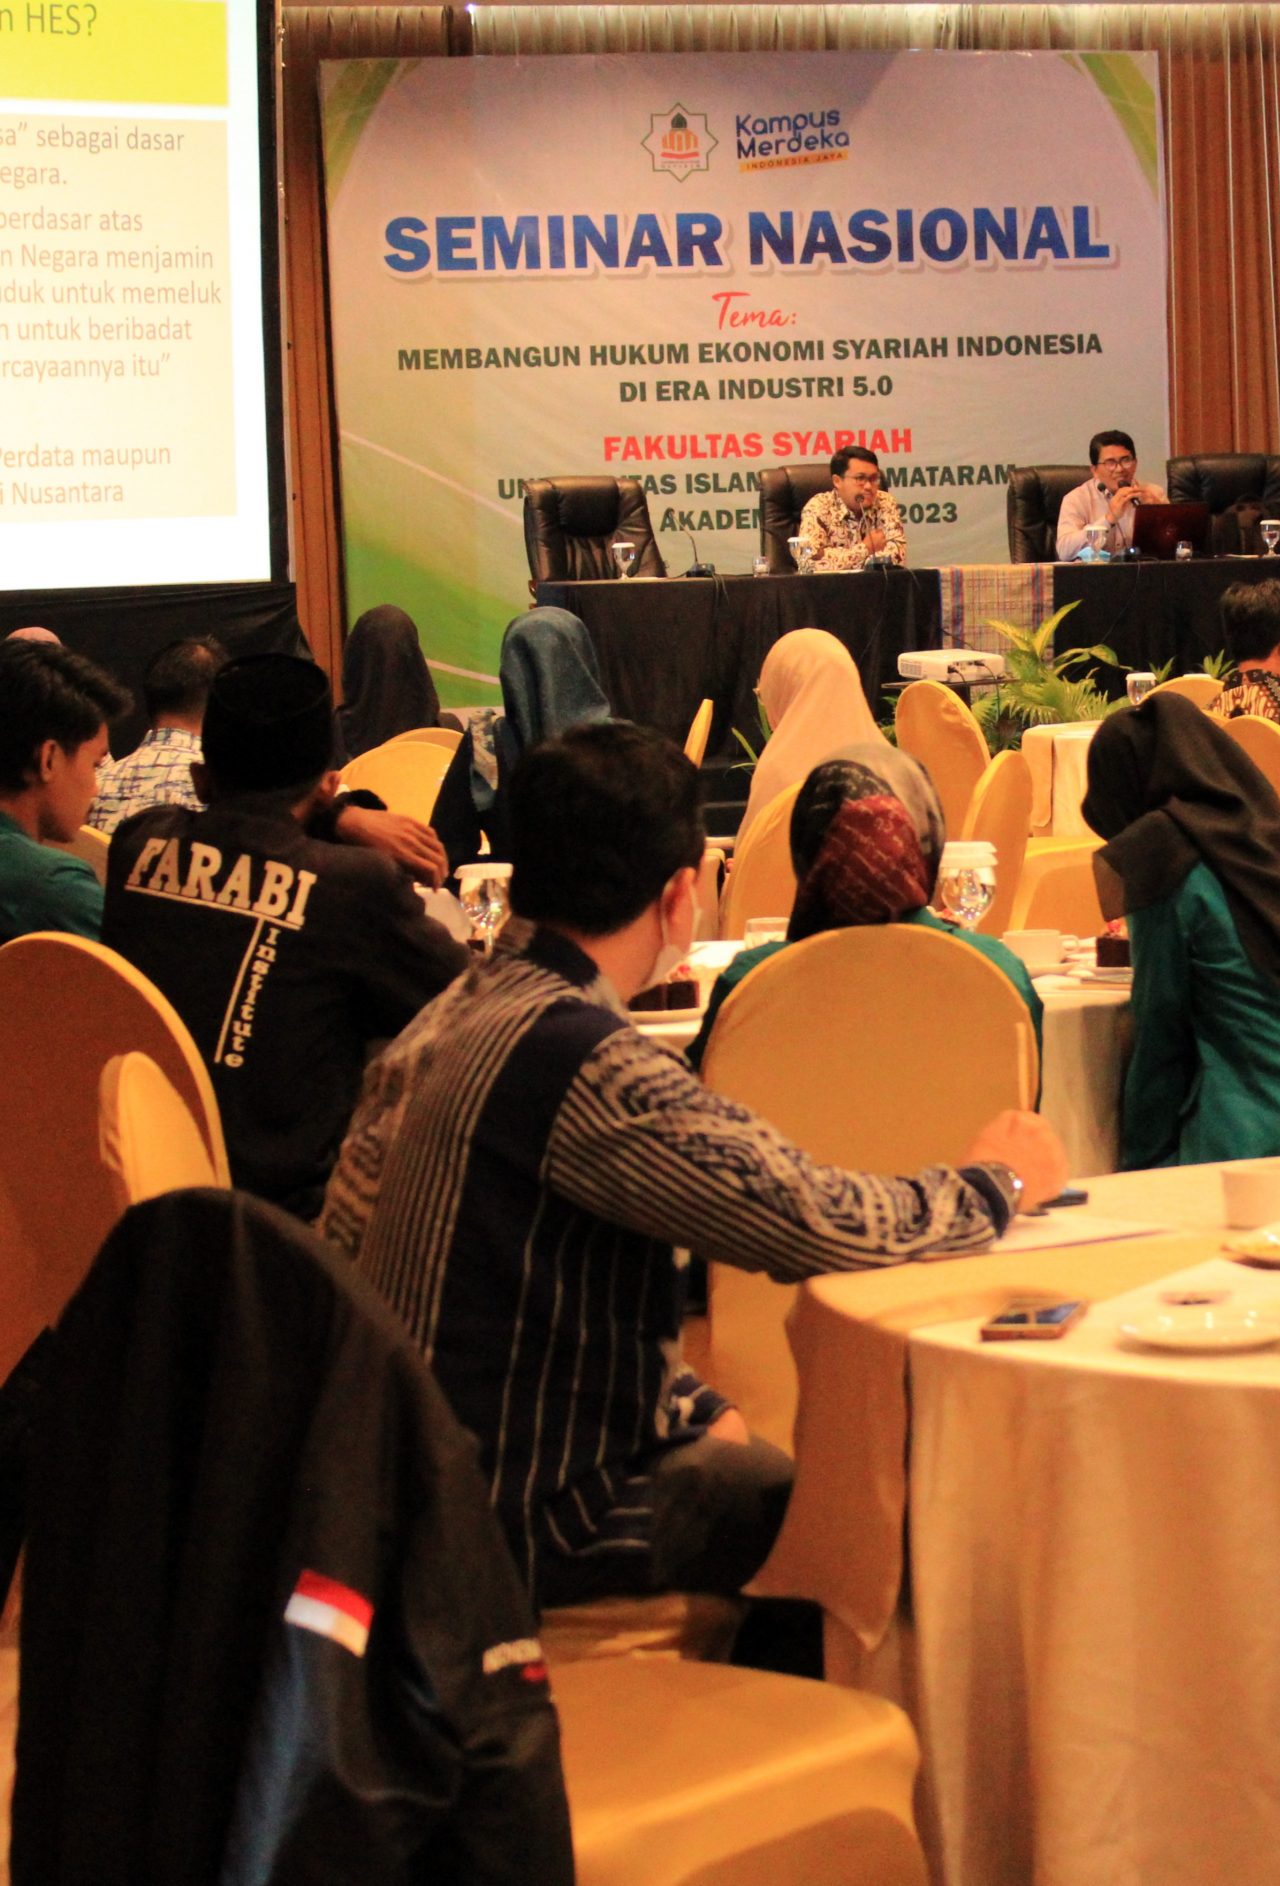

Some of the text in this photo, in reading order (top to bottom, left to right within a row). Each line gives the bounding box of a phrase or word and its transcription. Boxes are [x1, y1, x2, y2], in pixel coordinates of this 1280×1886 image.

[26, 2, 97, 36] HES?
[36, 124, 119, 154] sebagai
[126, 126, 185, 151] dasar
[735, 110, 840, 138] Kampus
[736, 129, 850, 160] Merdeka
[98, 209, 143, 232] atas
[383, 205, 1110, 273] SEMINAR NASIONAL
[21, 243, 98, 273] Negara
[106, 245, 214, 274] menjamin
[52, 280, 115, 304] untuk
[122, 280, 222, 305] memeluk
[711, 291, 797, 331] Tema:
[17, 316, 81, 341] untuk
[88, 315, 192, 341] beribadat
[397, 333, 1103, 371] MEMBANGUN HUKUM EKONOMI SYARIAH INDONESIA
[619, 374, 893, 403] DI ERA INDUSTRI 5.0
[82, 446, 171, 470] maupun
[603, 427, 913, 462] FAKULTAS SYARIAH
[12, 481, 124, 504] Nusantara
